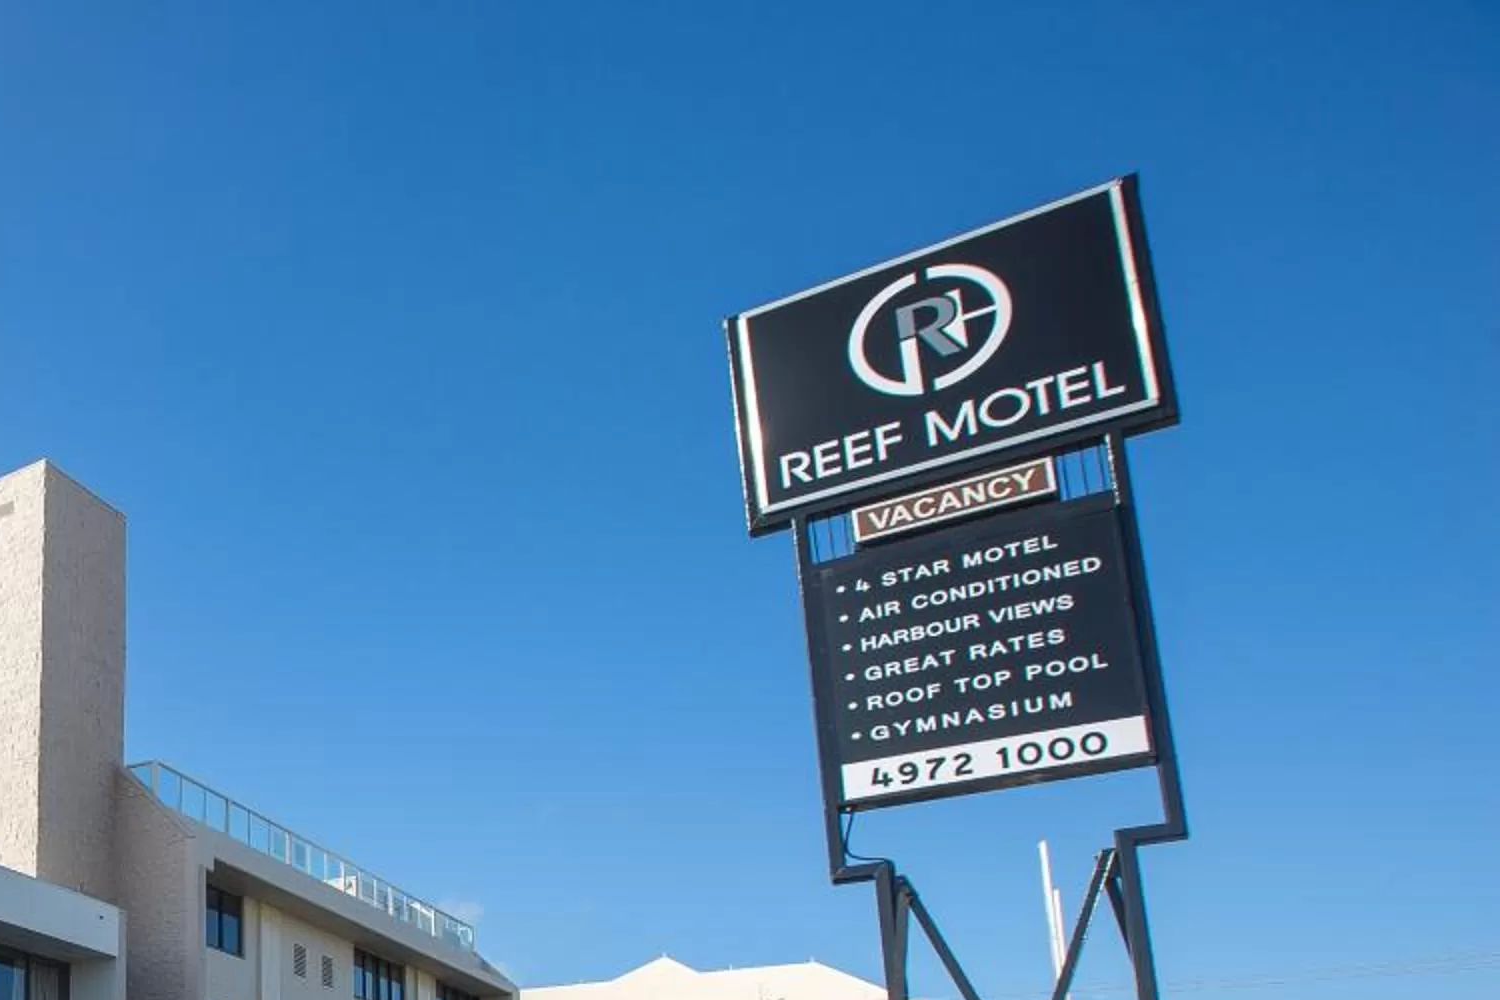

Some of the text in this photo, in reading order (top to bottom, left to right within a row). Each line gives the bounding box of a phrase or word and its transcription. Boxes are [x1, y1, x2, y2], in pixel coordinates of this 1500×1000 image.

[779, 360, 1125, 489] REEF MOTEL
[867, 468, 1037, 530] VACANCY
[855, 534, 1059, 592] 4 STAR MOTEL
[859, 556, 1102, 623] AIR CONDITIONED
[861, 594, 1075, 652] HARBOUR VIEWS
[864, 628, 1067, 682] GREAT RATES
[867, 652, 1109, 711] ROOF TOP POOL
[870, 691, 1073, 741] GYMNASIUM
[871, 731, 1108, 787] 4972 1000
